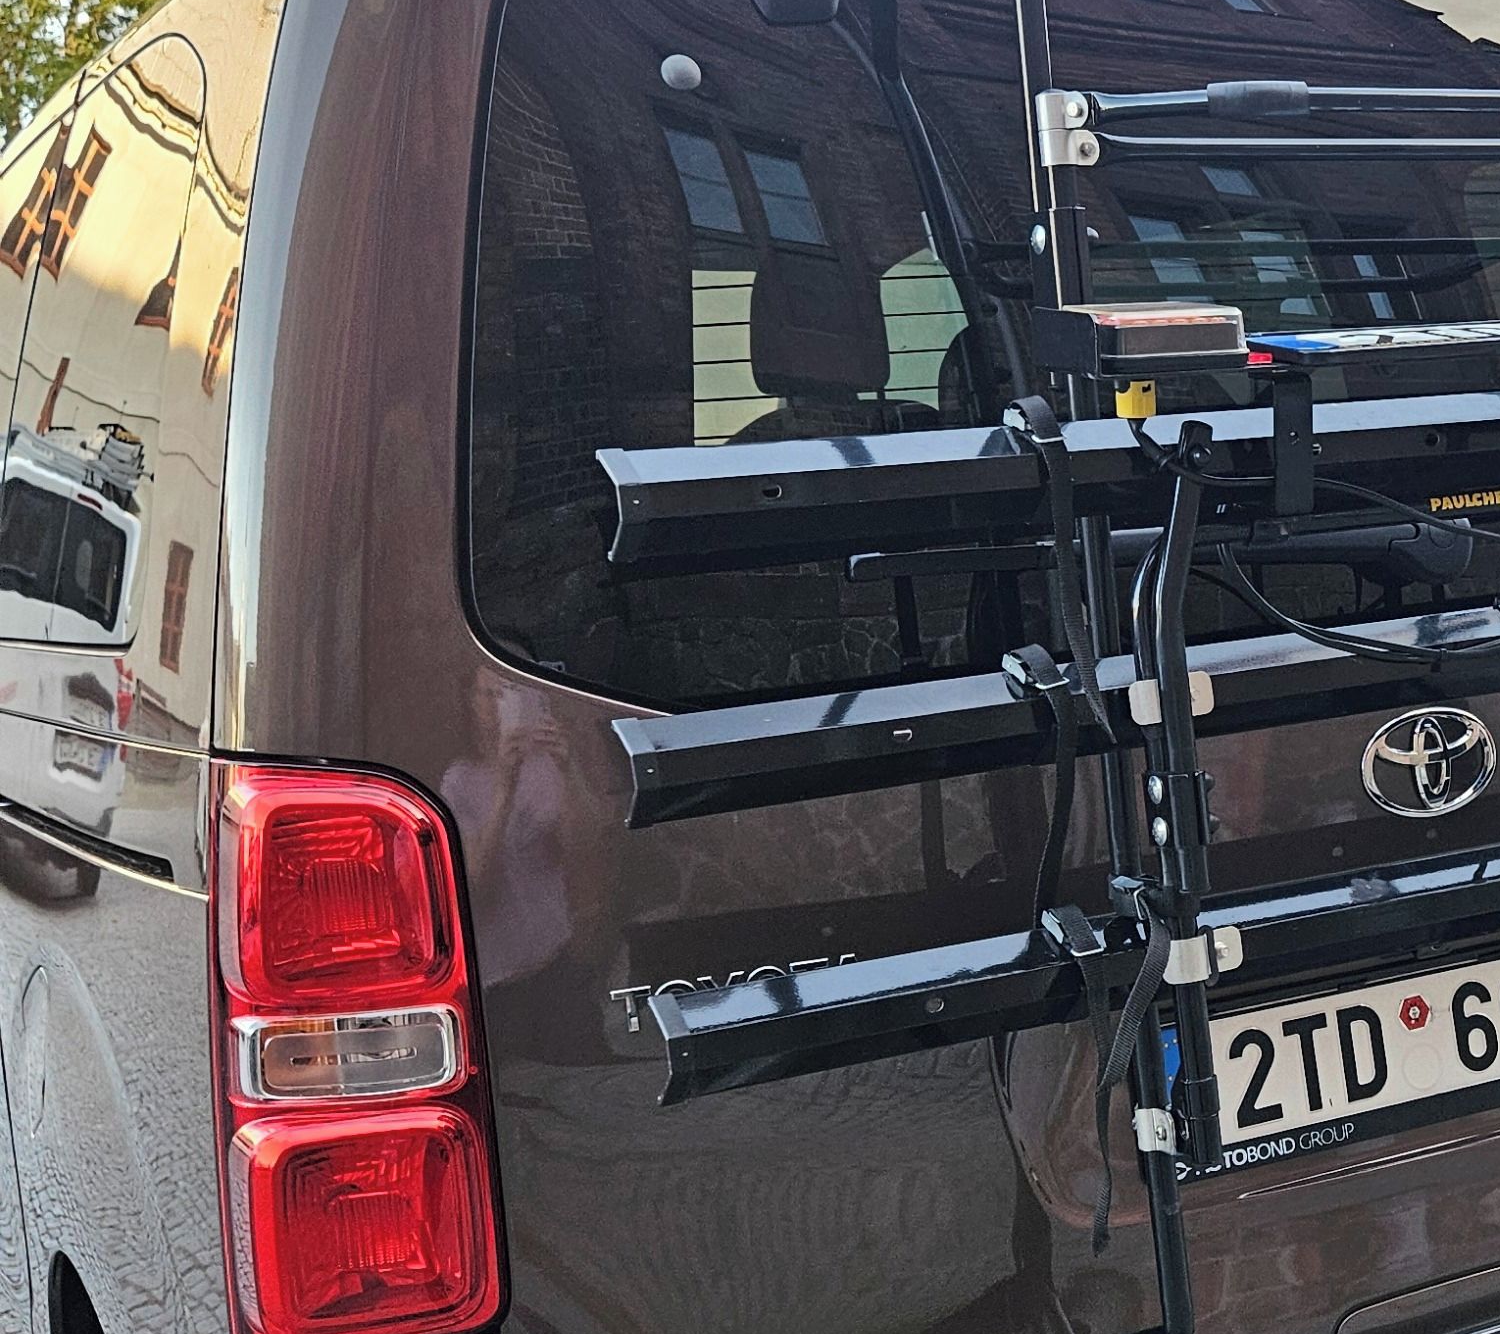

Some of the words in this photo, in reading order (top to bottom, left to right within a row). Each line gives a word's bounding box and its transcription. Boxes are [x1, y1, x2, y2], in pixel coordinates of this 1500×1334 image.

[1228, 1004, 1388, 1129] 2TD
[1196, 1137, 1296, 1177] TOBOND
[1299, 1122, 1355, 1151] GROUP
